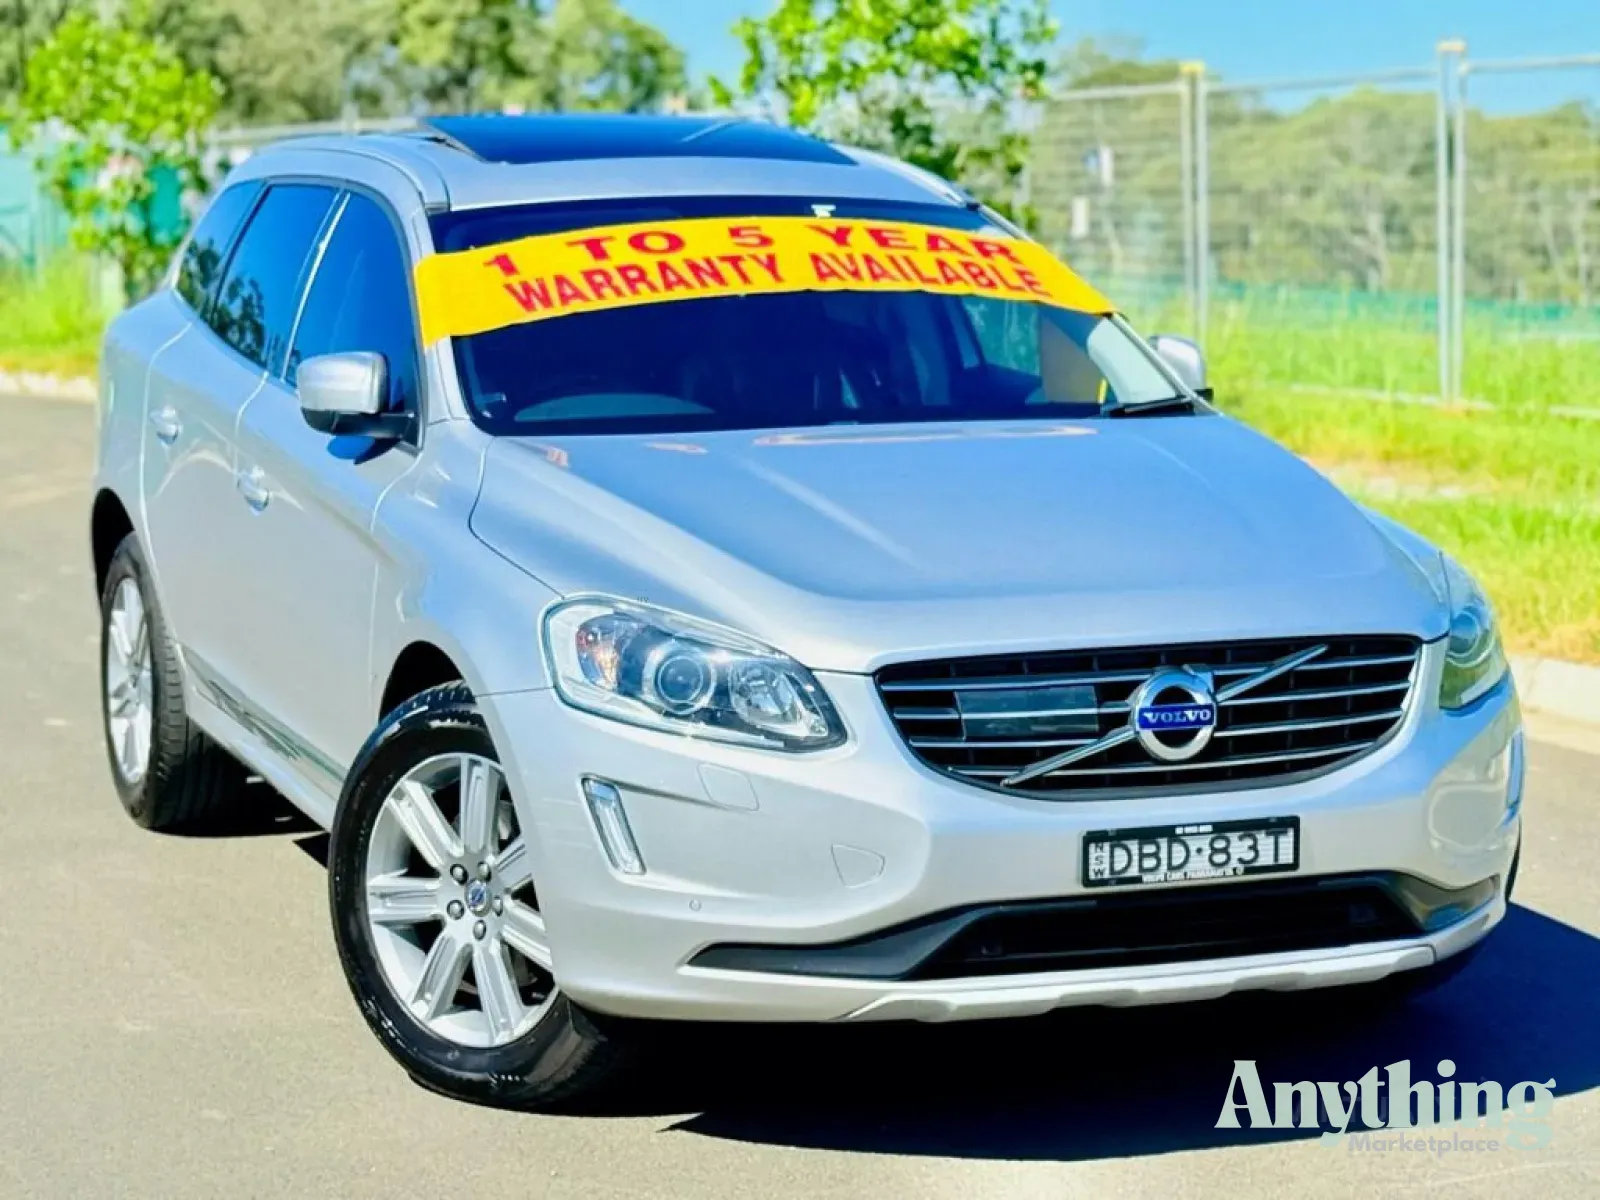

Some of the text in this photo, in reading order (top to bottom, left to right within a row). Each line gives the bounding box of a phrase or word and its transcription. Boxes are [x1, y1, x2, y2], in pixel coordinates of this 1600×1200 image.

[483, 224, 1024, 278] 1 TO 5 YEAR
[503, 251, 1053, 313] WARRANTY AVAILABLE
[1143, 708, 1212, 723] VOLVO
